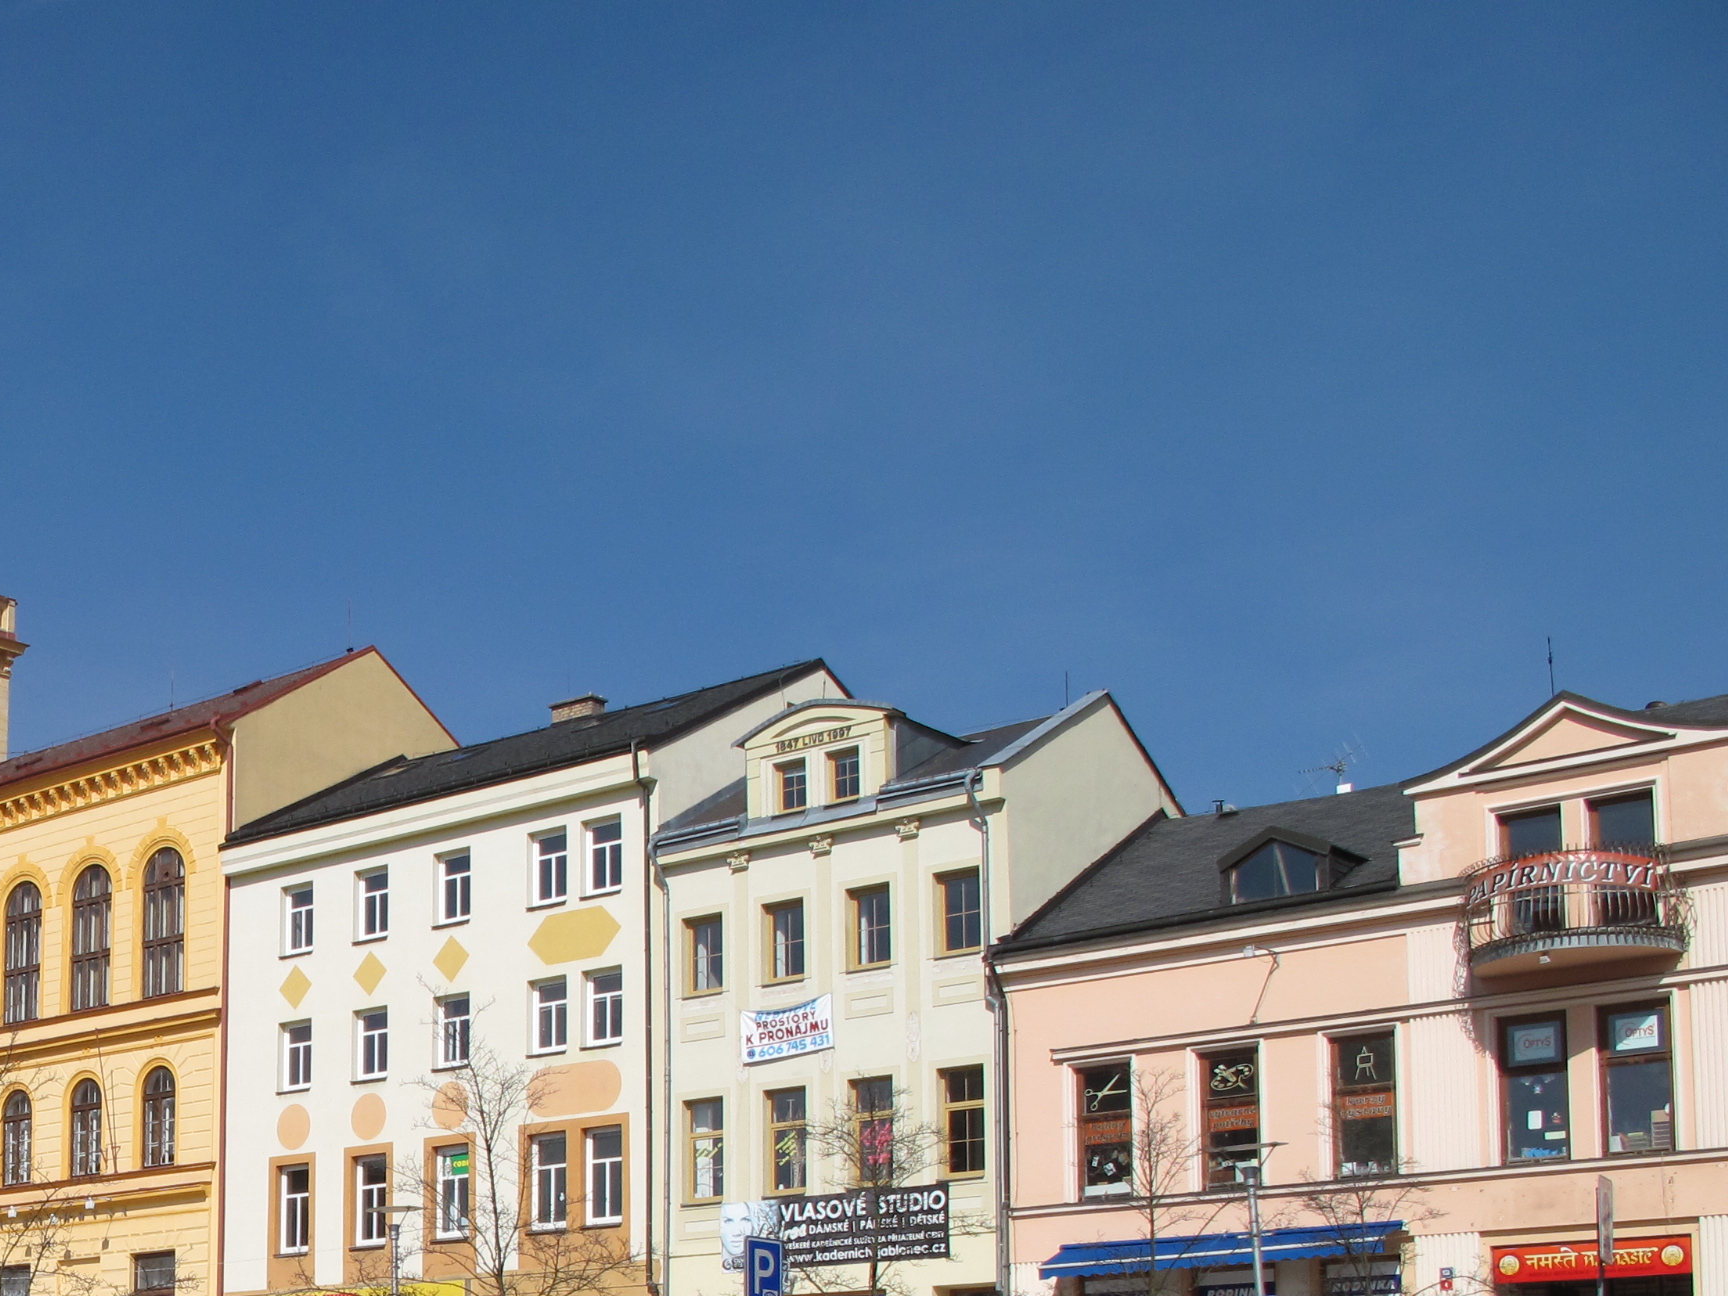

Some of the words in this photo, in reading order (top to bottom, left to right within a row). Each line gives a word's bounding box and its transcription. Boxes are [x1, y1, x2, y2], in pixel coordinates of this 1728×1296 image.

[775, 739, 799, 753] 1847
[827, 726, 852, 741] 1997
[1466, 861, 1654, 910] PAPÍRNICTVÍ
[746, 1034, 754, 1046] K
[759, 1018, 829, 1044] PRONÁJMU
[756, 1010, 816, 1031] PROSTORY
[758, 1044, 784, 1058] 606
[786, 1039, 807, 1052] 745
[810, 1034, 830, 1047] 431
[780, 1191, 867, 1222] VLASOVÉ
[877, 1189, 946, 1215] STUDIO
[809, 1221, 849, 1235] DÁMSKÉ
[753, 1248, 775, 1295] P
[1524, 1246, 1579, 1270] नमस्ते
